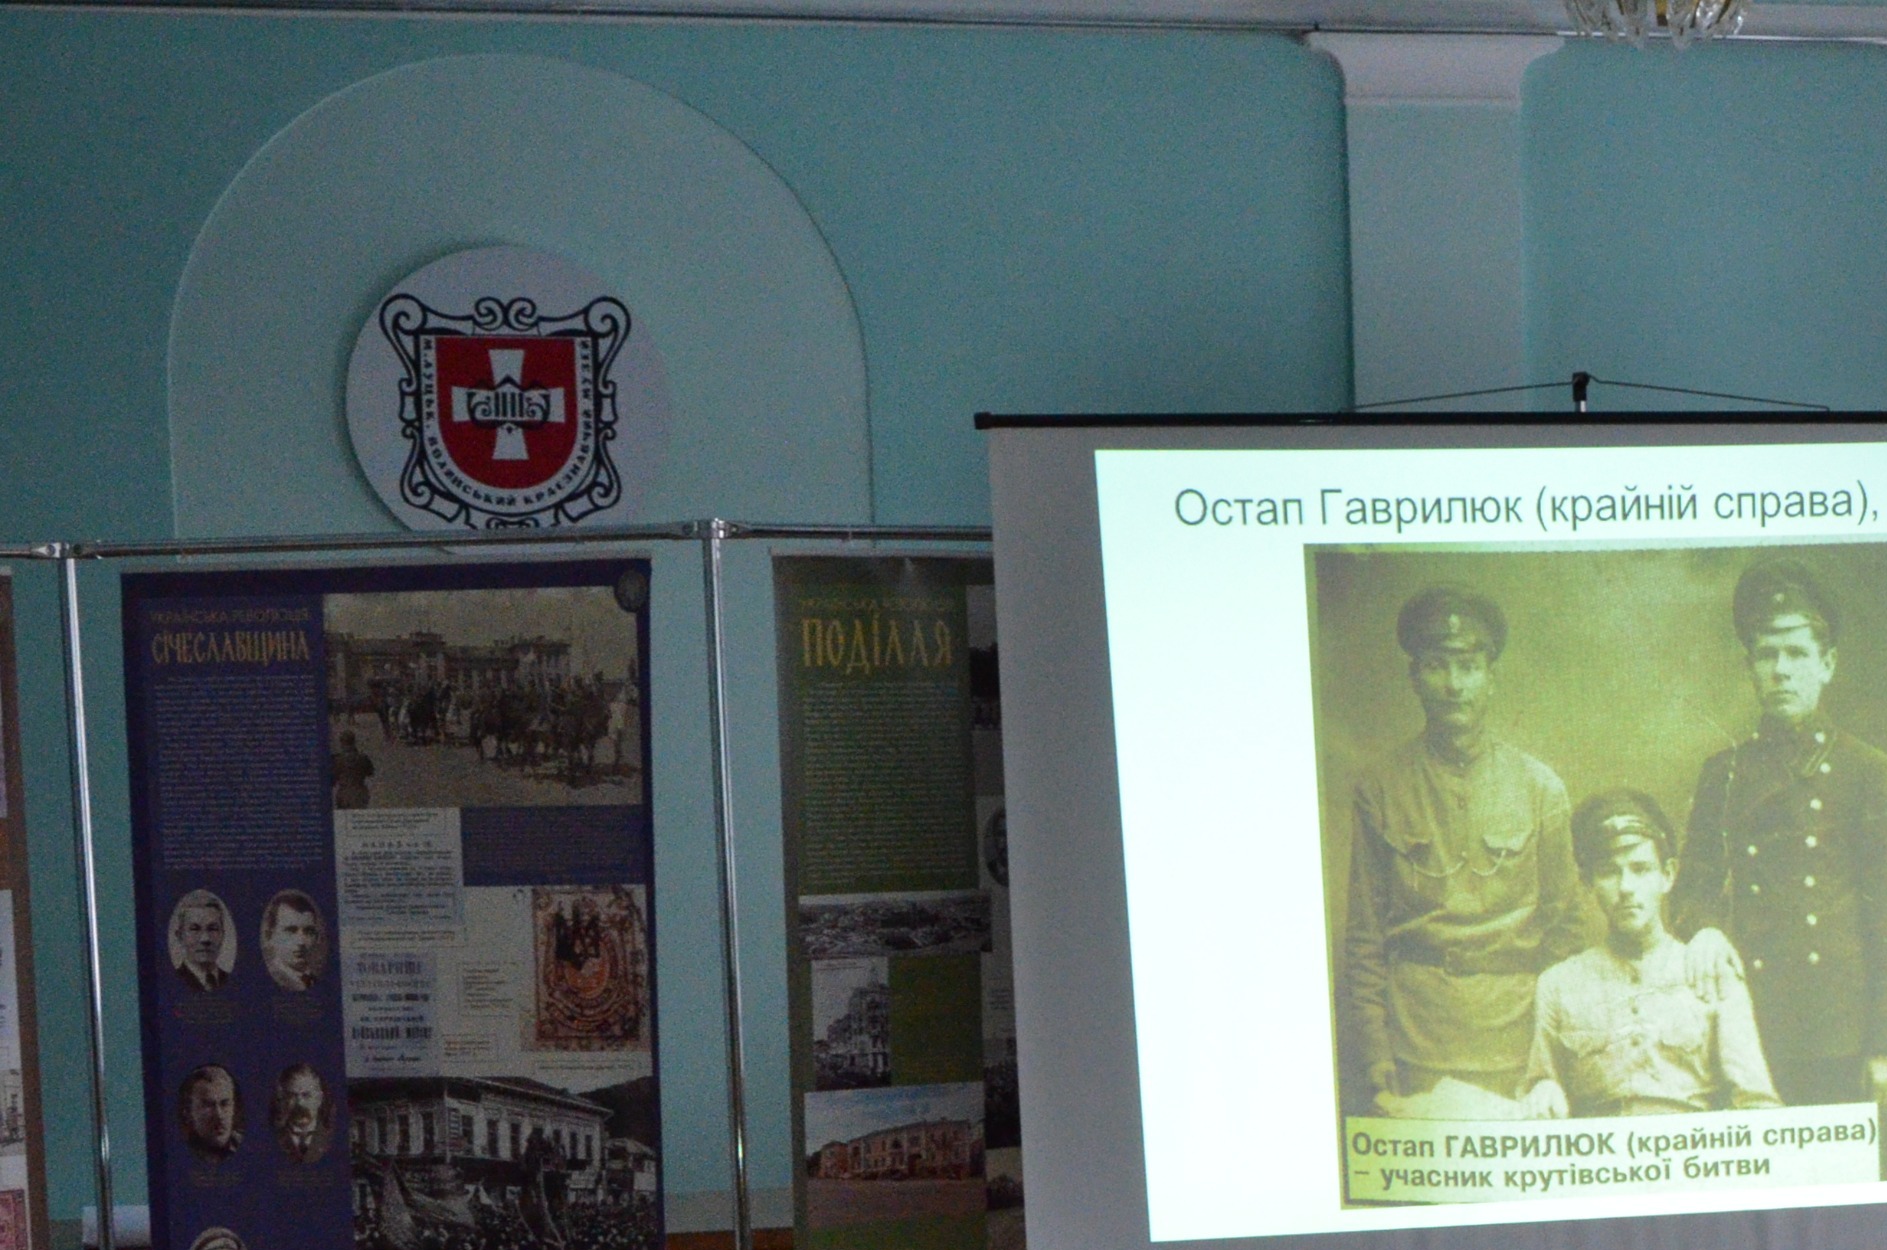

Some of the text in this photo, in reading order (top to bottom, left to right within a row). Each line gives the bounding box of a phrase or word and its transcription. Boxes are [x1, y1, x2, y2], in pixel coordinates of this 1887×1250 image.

[1175, 488, 1303, 526] Остап
[1320, 488, 1522, 534] Гаврилюк
[1536, 484, 1697, 532] (крайній
[1714, 479, 1878, 528] справа),
[802, 612, 951, 675] ПОДІЛЛЯ
[1351, 1117, 1877, 1159] Остап ГАВРИЛЮК (крайній справа)
[1380, 1167, 1494, 1191] учасник
[1504, 1158, 1671, 1192] крутівської
[1683, 1155, 1771, 1179] битви
